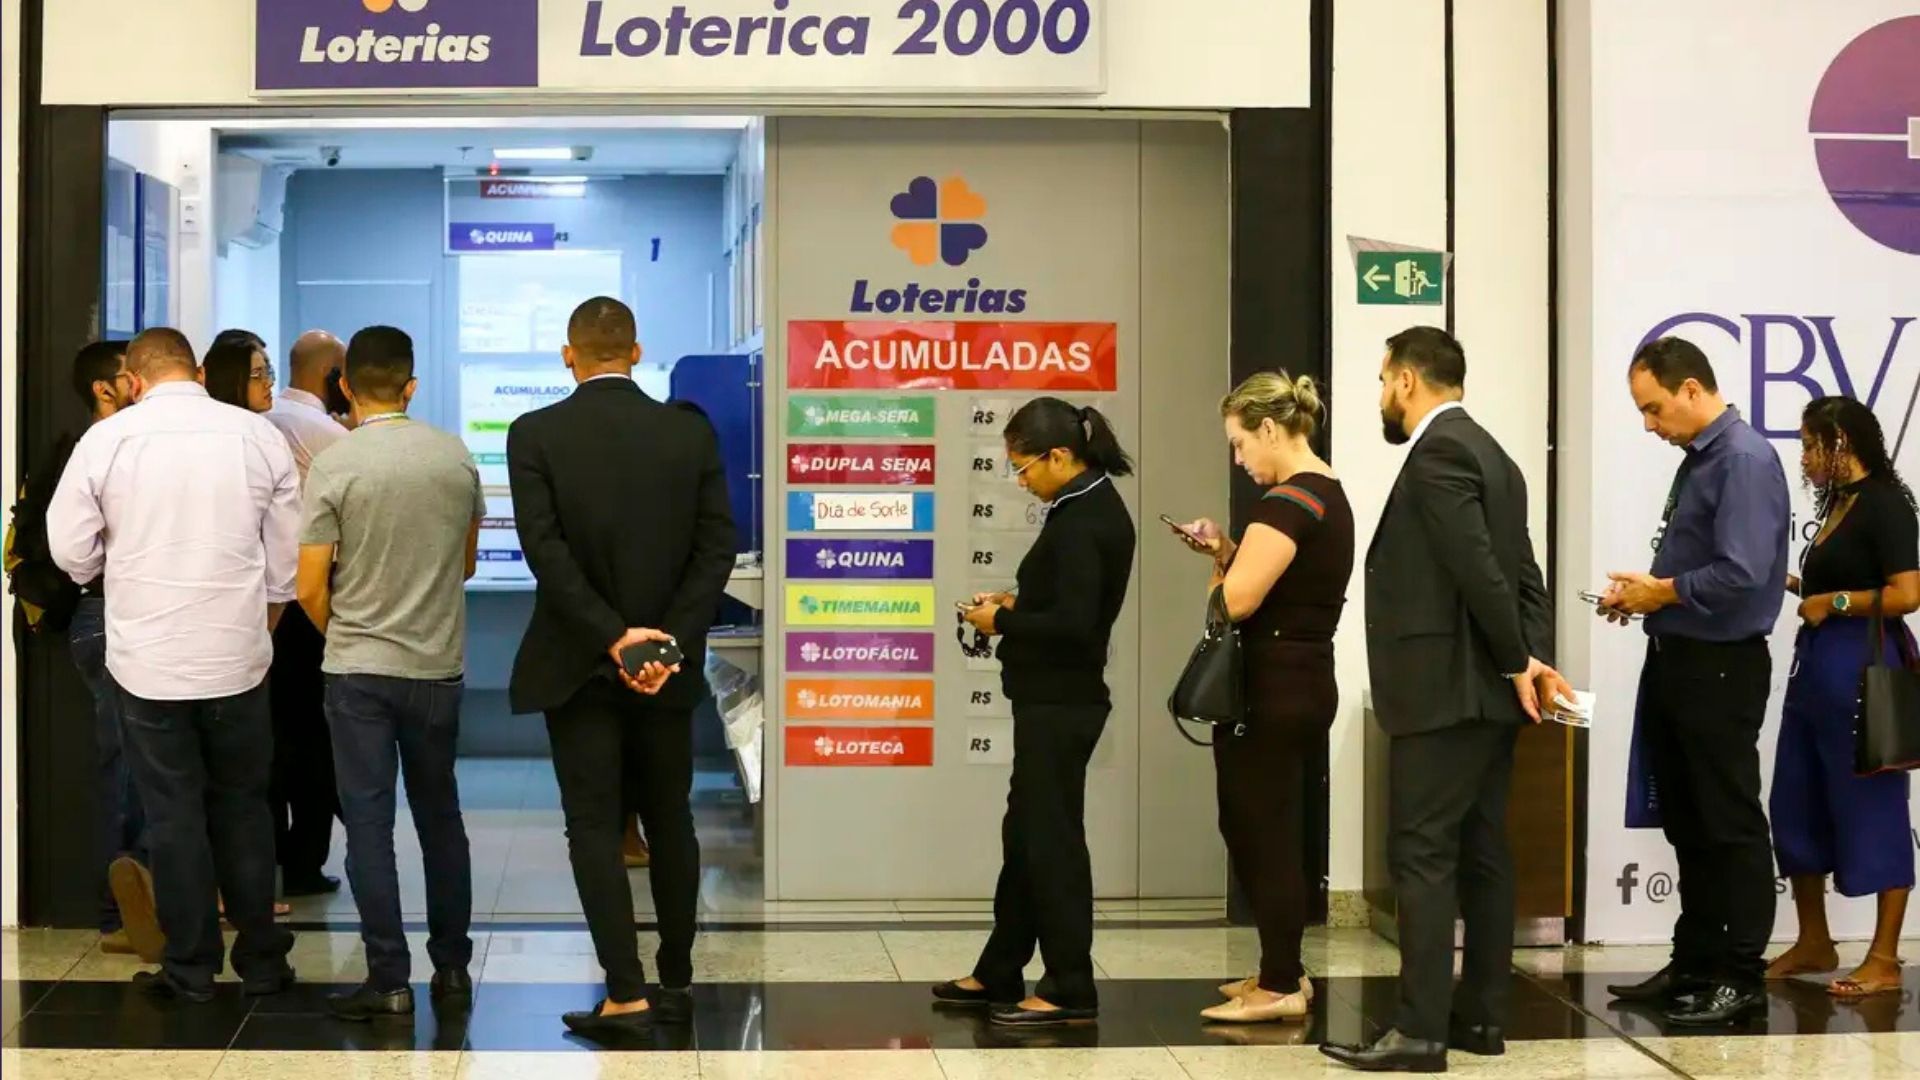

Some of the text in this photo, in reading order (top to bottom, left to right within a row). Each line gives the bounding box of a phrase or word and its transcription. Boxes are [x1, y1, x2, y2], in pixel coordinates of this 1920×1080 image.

[579, 0, 1090, 57] Loterica 2000
[300, 25, 490, 63] Loterias
[485, 231, 534, 243] QUINA
[850, 278, 1027, 313] Loterias
[815, 340, 1092, 372] ACUMULADAS
[494, 385, 571, 396] ACUMULADO
[826, 407, 920, 424] MEGA-SENA
[811, 457, 874, 471] DUPLA
[880, 457, 932, 472] SENA
[817, 500, 909, 519] Dia de Sorte
[838, 552, 905, 568] QUINA
[821, 600, 921, 614] TIMEMANIA
[822, 643, 920, 661] LOTOFÁCIL
[818, 691, 992, 709] LOTOMANIA R$
[836, 738, 992, 755] LOTECA R$
